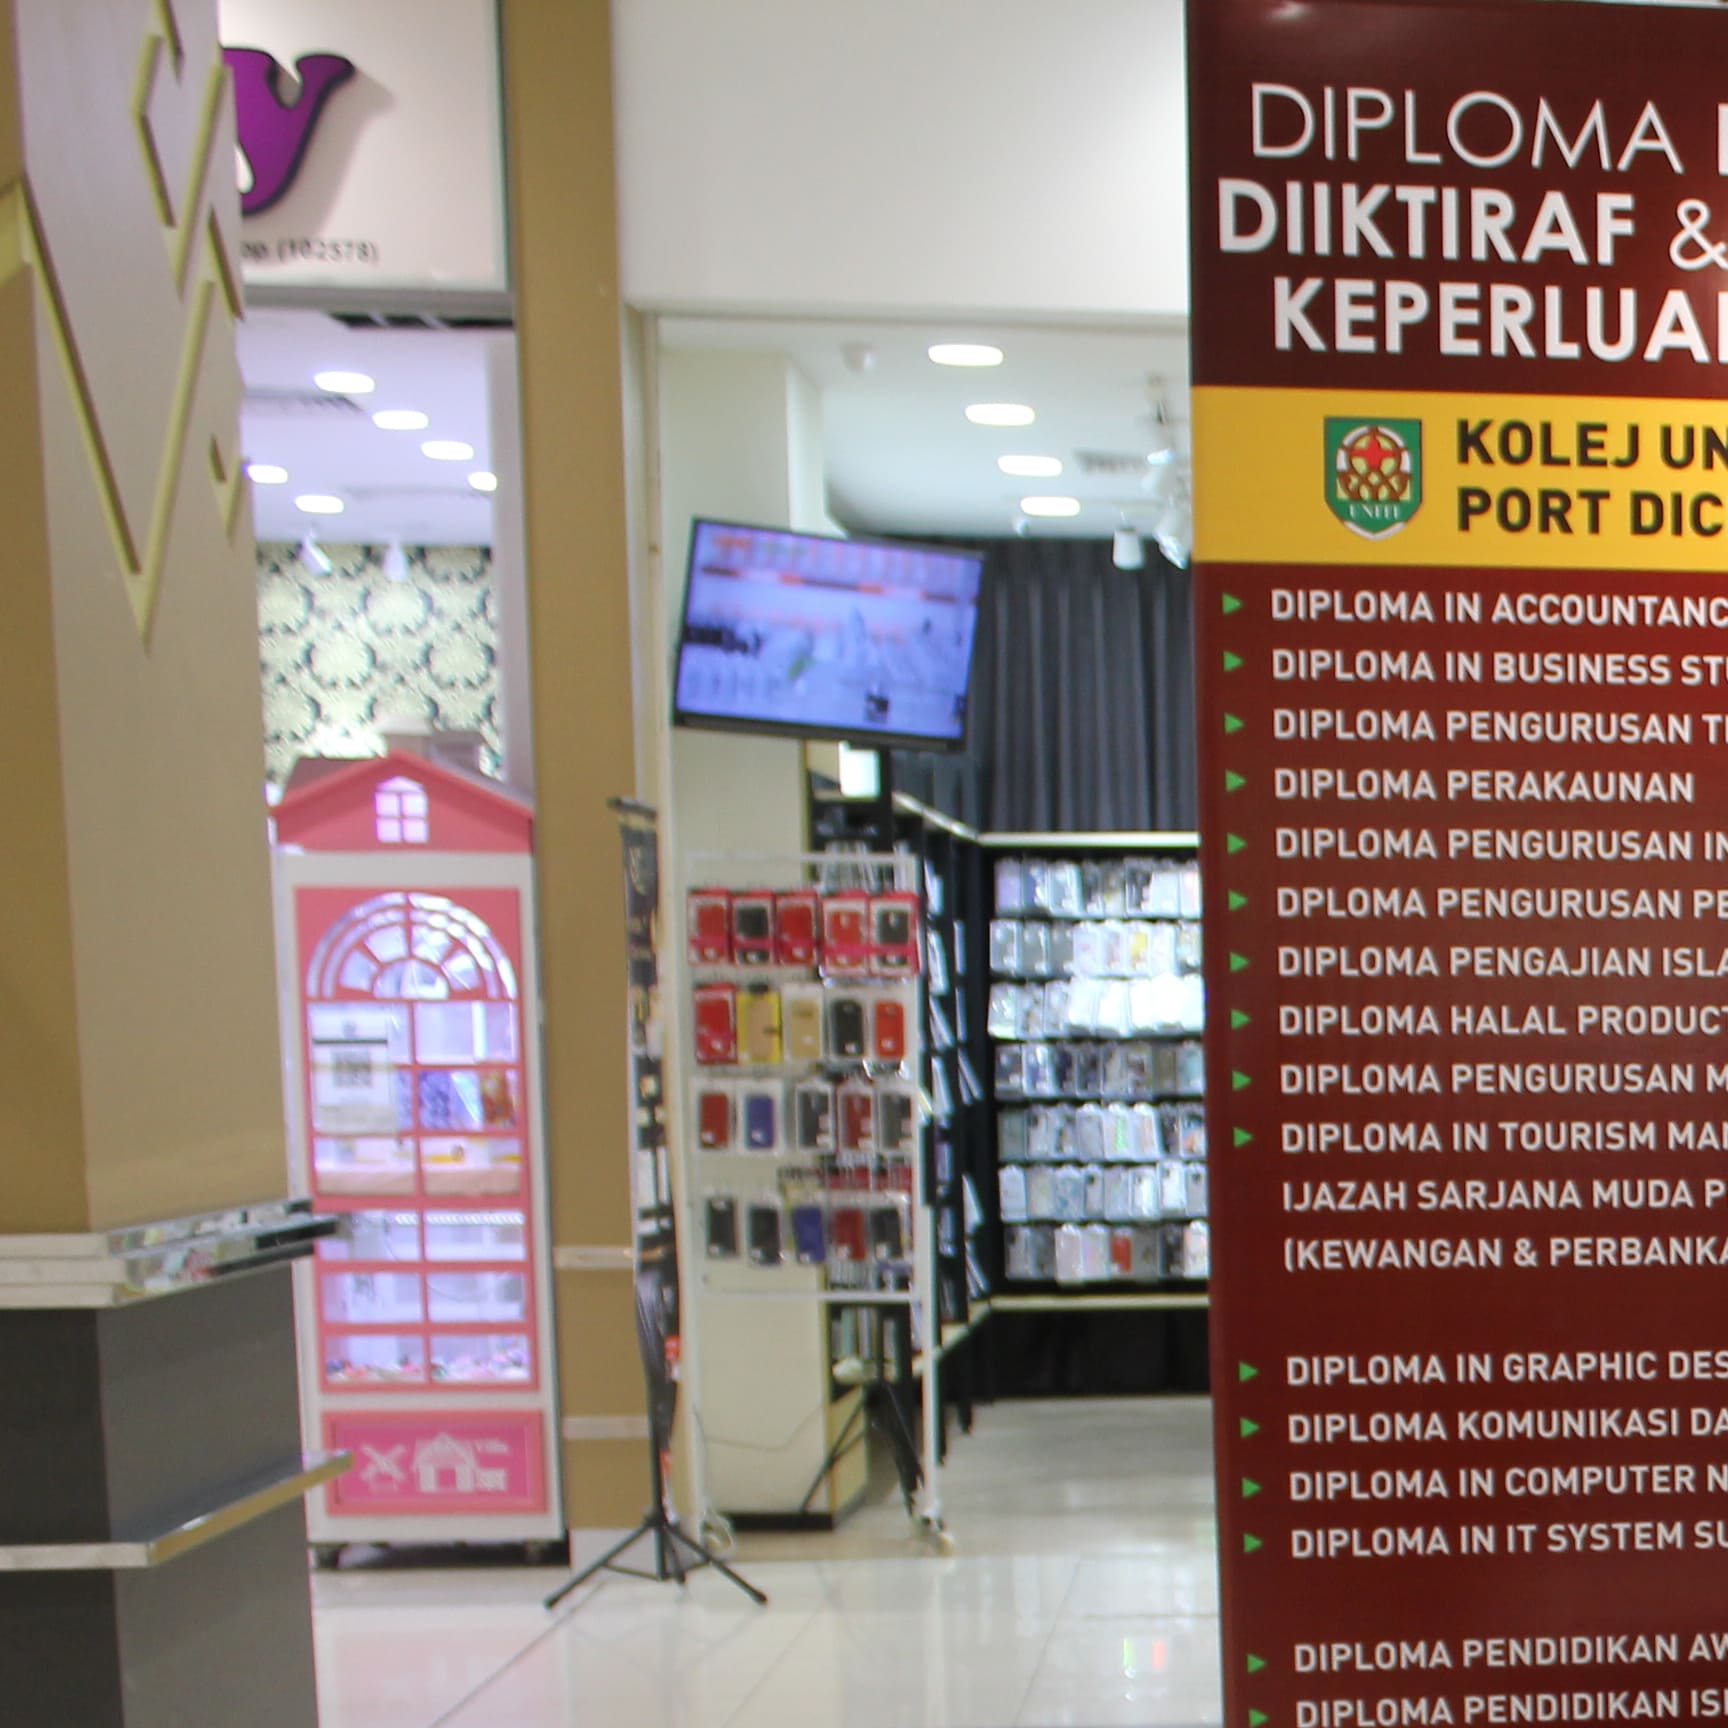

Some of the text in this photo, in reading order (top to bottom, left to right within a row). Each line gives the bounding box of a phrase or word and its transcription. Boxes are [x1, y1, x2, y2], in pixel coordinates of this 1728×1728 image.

[1252, 83, 1684, 175] DIPLOMA
[1218, 178, 1635, 266] DIIKTIRAF
[1457, 419, 1640, 468] KOLEJ
[1458, 486, 1611, 535] PORT
[1271, 589, 1435, 623] DIPLOMA
[1445, 591, 1482, 623] IN
[1273, 708, 1436, 741] DIPLOMA
[1446, 710, 1692, 744] PENGURUSAN
[1274, 768, 1694, 803] DIPLOMA PERAKAUNAN
[1277, 887, 1427, 918] DPLOMA
[1437, 888, 1682, 919] PENGURUSAN
[1279, 1005, 1441, 1036] DIPLOMA
[1451, 1005, 1568, 1035] HALAL
[1281, 1122, 1443, 1153] DIPLOMA
[1452, 1122, 1489, 1152] IN
[1498, 1121, 1656, 1152] TOURISM
[1283, 1181, 1407, 1212] IJAZAH
[1417, 1179, 1583, 1211] SARJANA
[1592, 1179, 1695, 1209] MUDA
[1284, 1237, 1503, 1273] (KEWANGAN
[1513, 1237, 1538, 1267] &
[1287, 1354, 1447, 1386] DIPLOMA
[1456, 1353, 1492, 1383] IN
[1503, 1351, 1657, 1382] GRAPHIC
[1288, 1412, 1448, 1444] DIPLOMA
[1458, 1407, 1679, 1441] KOMUNIKASI
[1290, 1469, 1449, 1501] DIPLOMA
[1459, 1468, 1495, 1497] IN
[1505, 1464, 1696, 1497] COMPUTER
[1291, 1526, 1450, 1559] DIPLOMA
[1460, 1525, 1496, 1554] IN
[1507, 1523, 1538, 1553] IT
[1547, 1521, 1684, 1553] SYSTEM
[1294, 1640, 1453, 1673] DIPLOMA
[1463, 1633, 1678, 1668] PENDIDIKAN
